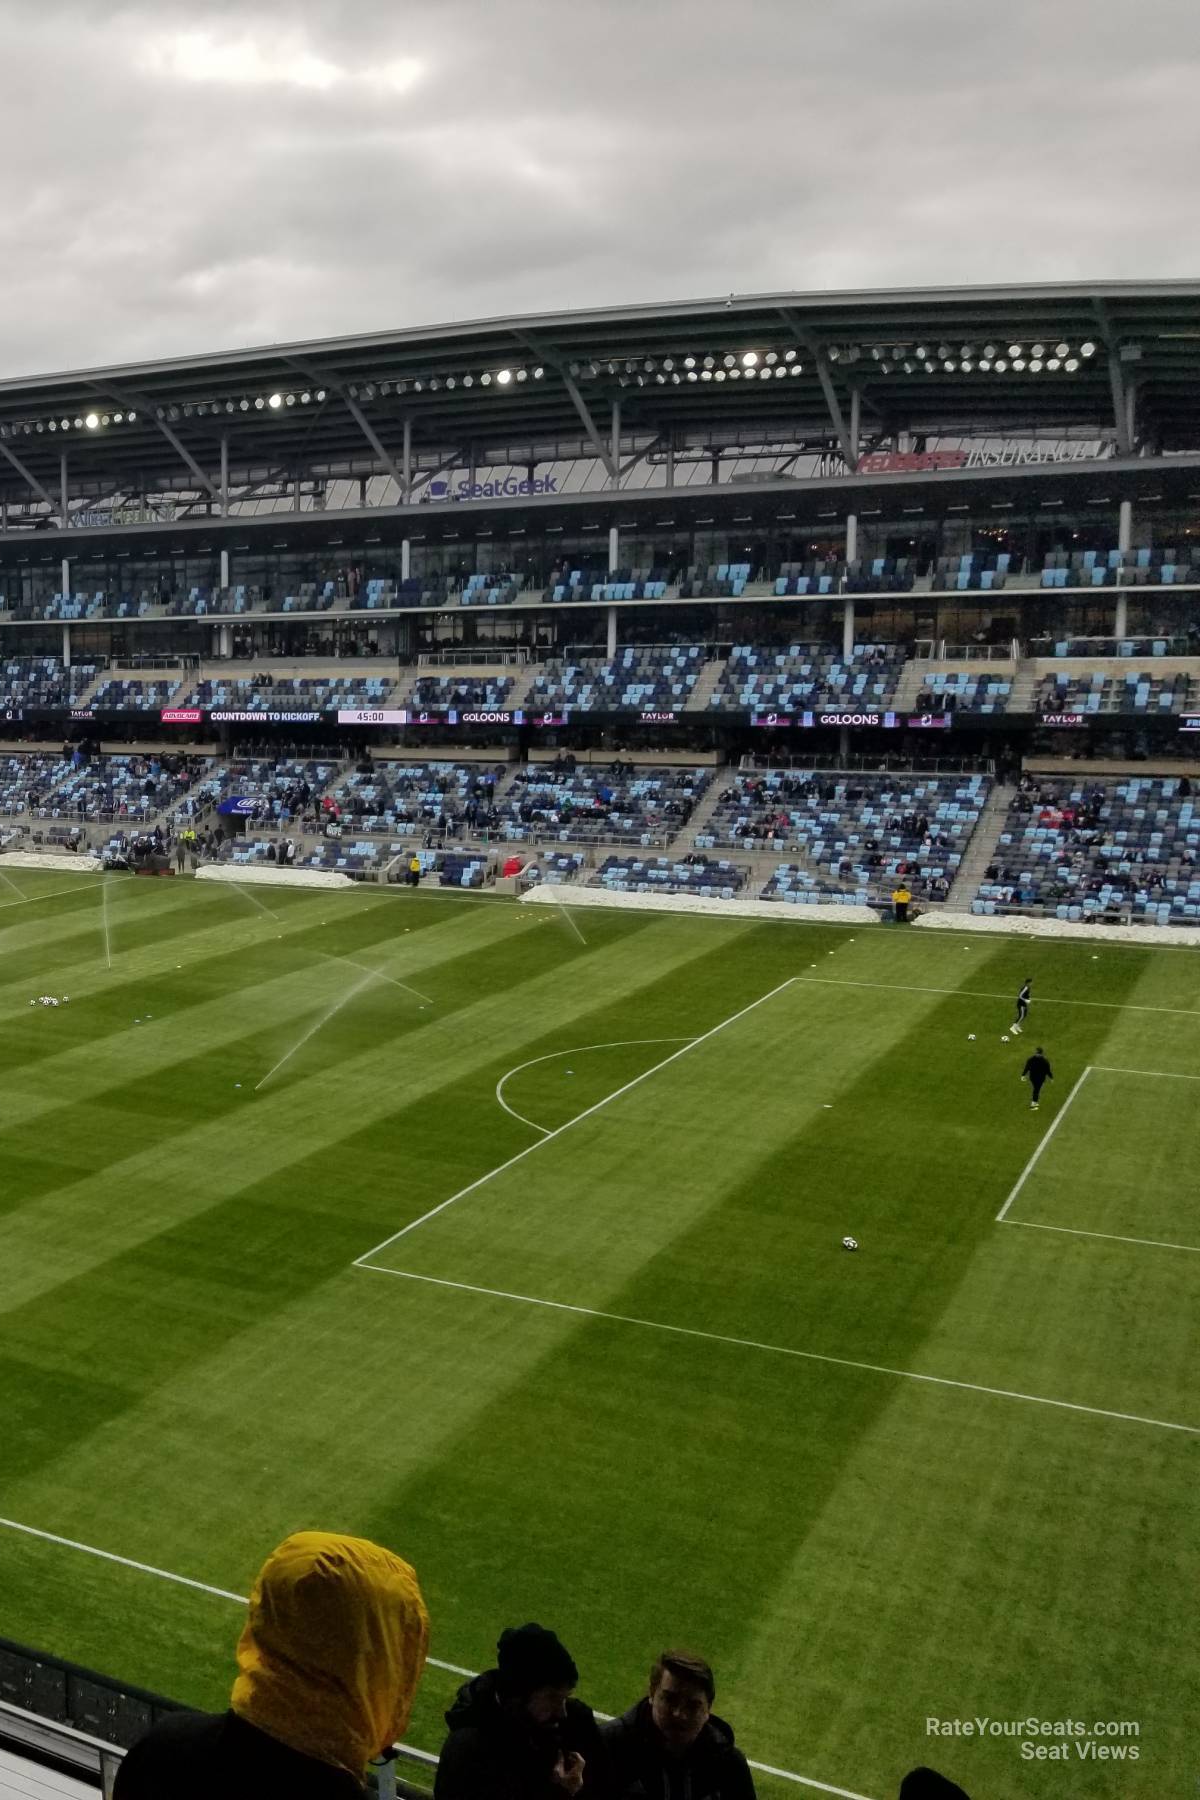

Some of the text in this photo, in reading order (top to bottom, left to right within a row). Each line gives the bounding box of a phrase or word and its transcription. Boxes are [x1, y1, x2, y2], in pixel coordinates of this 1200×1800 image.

[966, 446, 1088, 467] INSURANCE
[458, 474, 557, 499] SeatGeek
[210, 712, 267, 721] COUNTDOWN
[268, 712, 280, 720] TO
[356, 712, 384, 721] 45:00
